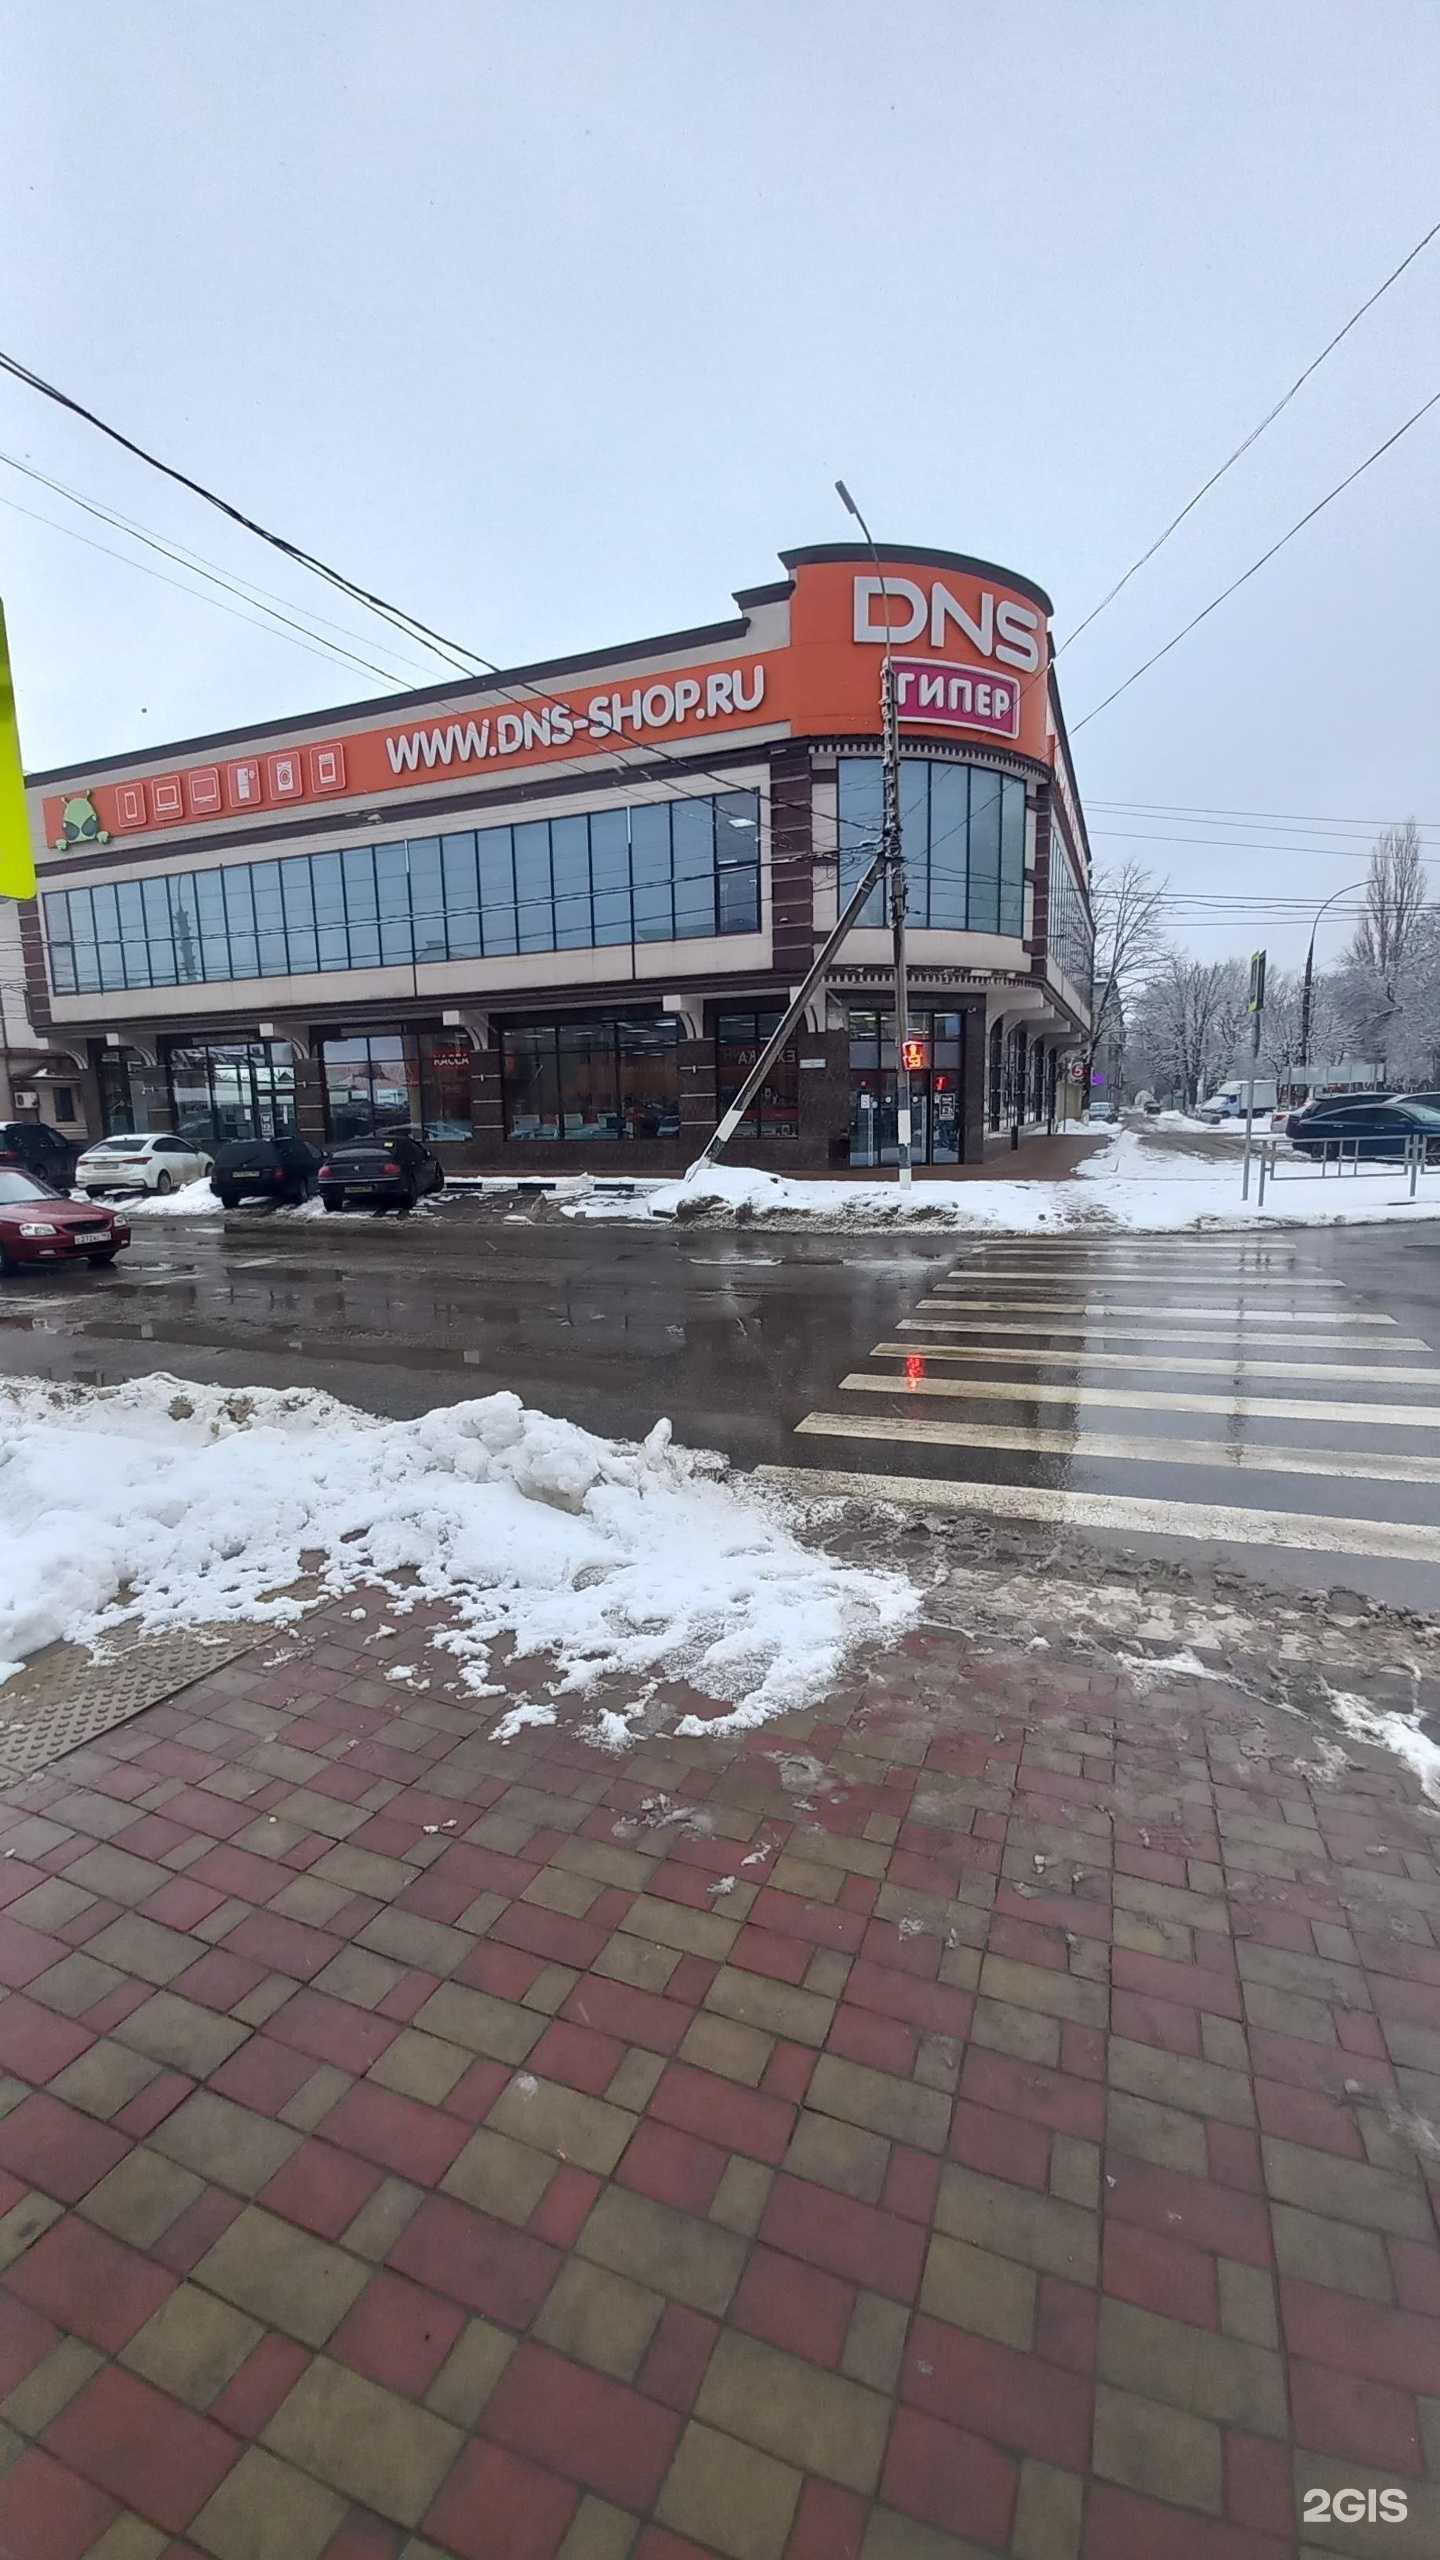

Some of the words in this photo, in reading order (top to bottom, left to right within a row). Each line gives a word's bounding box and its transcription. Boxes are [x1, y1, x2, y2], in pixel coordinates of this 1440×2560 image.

[853, 575, 1039, 674] DNS
[386, 664, 766, 774] WWW.DNS-SHOP.RU
[894, 672, 1011, 720] ГИПЕР
[433, 1054, 470, 1066] КАССА
